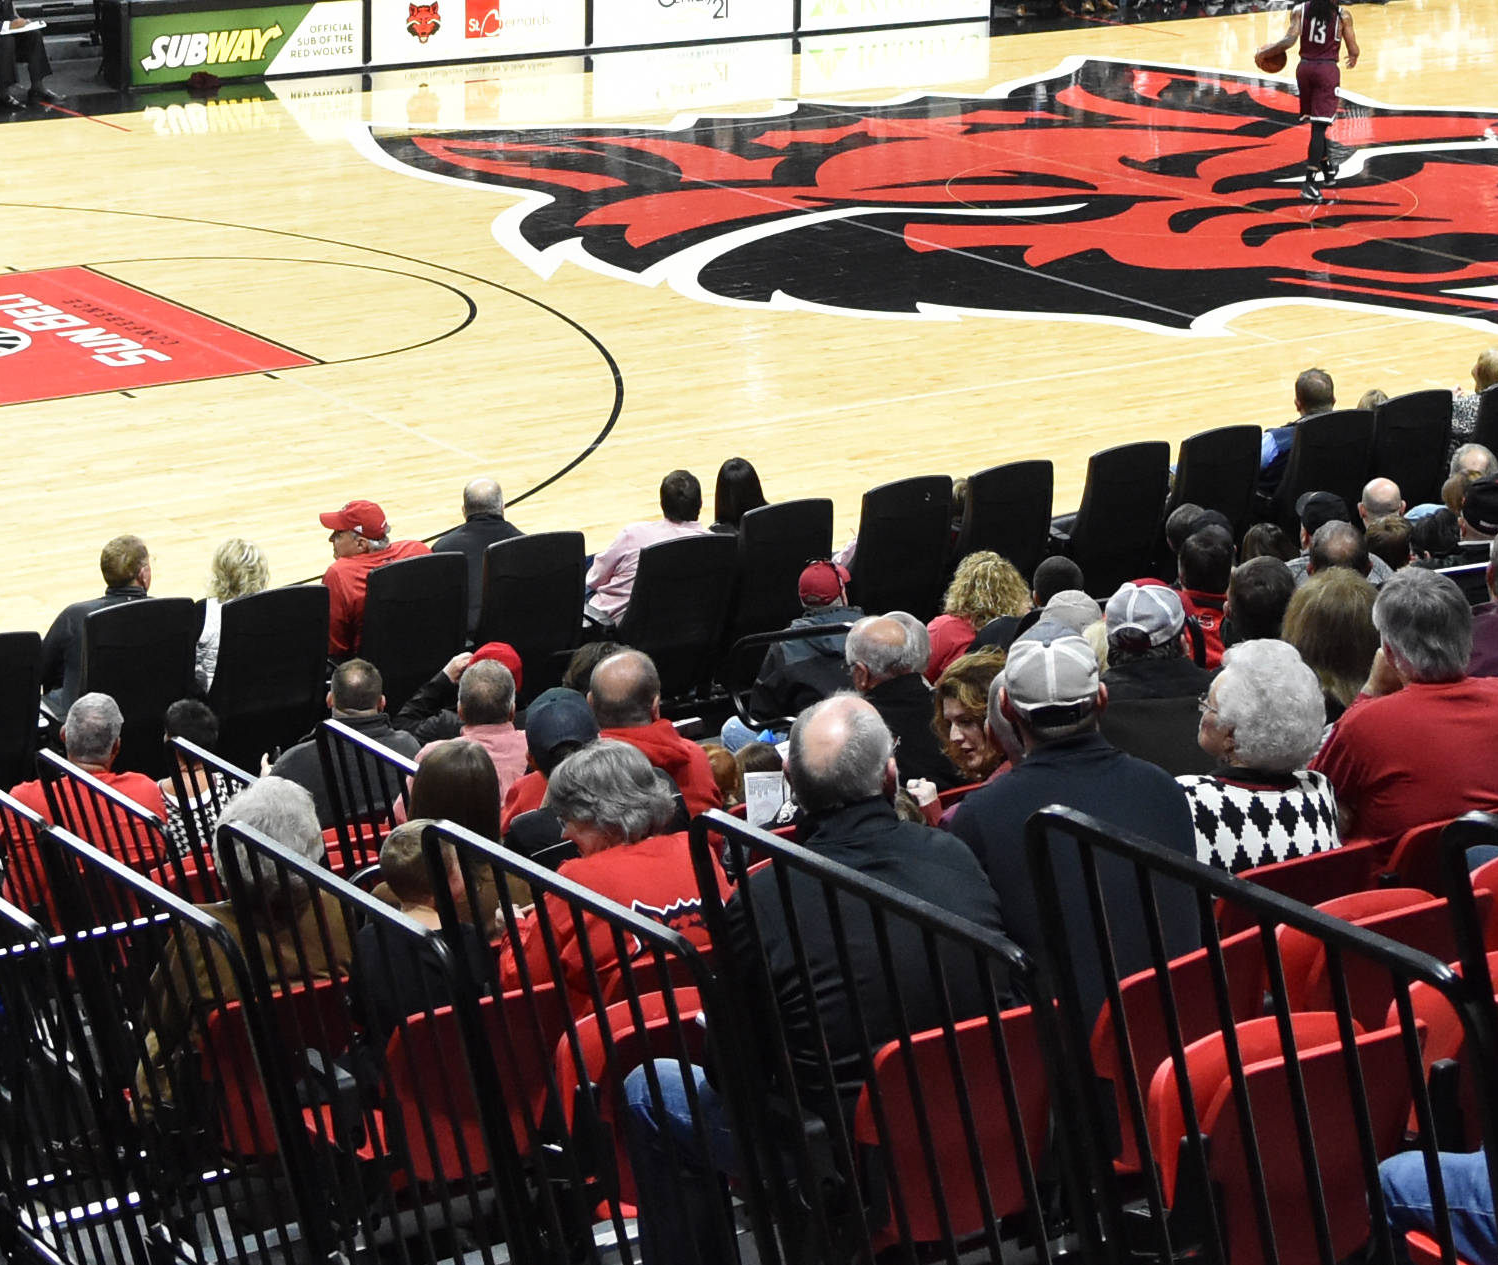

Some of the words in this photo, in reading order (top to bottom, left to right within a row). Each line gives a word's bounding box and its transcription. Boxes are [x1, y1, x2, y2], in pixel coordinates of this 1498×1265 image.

[309, 22, 354, 34] OFFICIAL
[1309, 18, 1327, 44] 13
[141, 24, 283, 72] SUBWAY
[297, 36, 317, 46] SUB
[319, 35, 332, 45] OF
[335, 33, 353, 43] THE
[290, 48, 310, 59] RED
[314, 45, 354, 57] WOLVES
[55, 327, 173, 367] SUN
